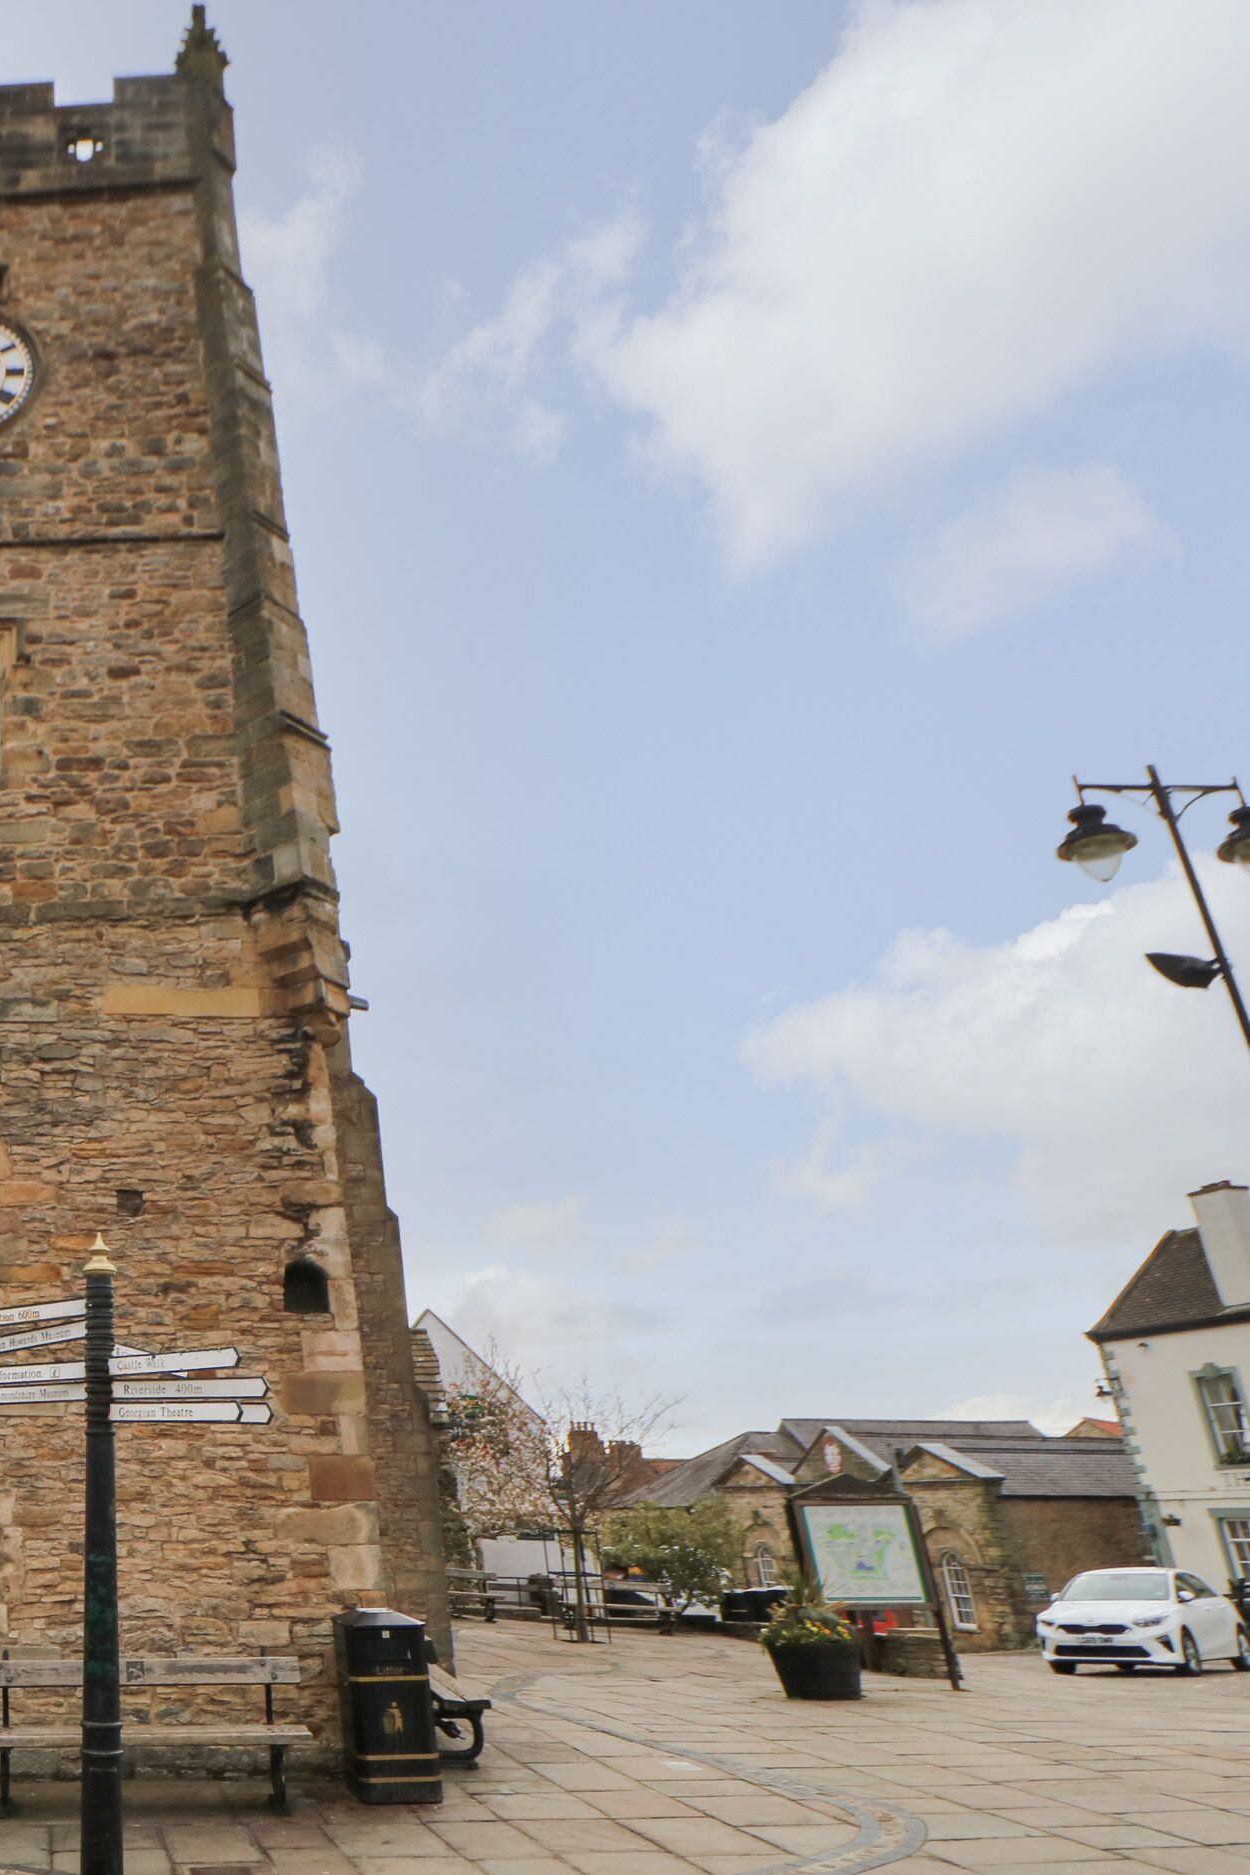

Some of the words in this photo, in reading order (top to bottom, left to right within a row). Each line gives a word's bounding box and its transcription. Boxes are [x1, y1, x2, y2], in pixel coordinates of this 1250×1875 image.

[17, 1309, 41, 1320] 600m
[9, 1333, 38, 1347] Howards
[41, 1328, 71, 1341] Museum
[117, 1360, 142, 1371] Castle
[145, 1357, 165, 1368] Walk
[39, 1388, 69, 1399] Museum
[123, 1384, 167, 1395] Riverside
[175, 1383, 203, 1394] 400m
[119, 1407, 156, 1419] Georgian
[160, 1406, 193, 1417] Theatre
